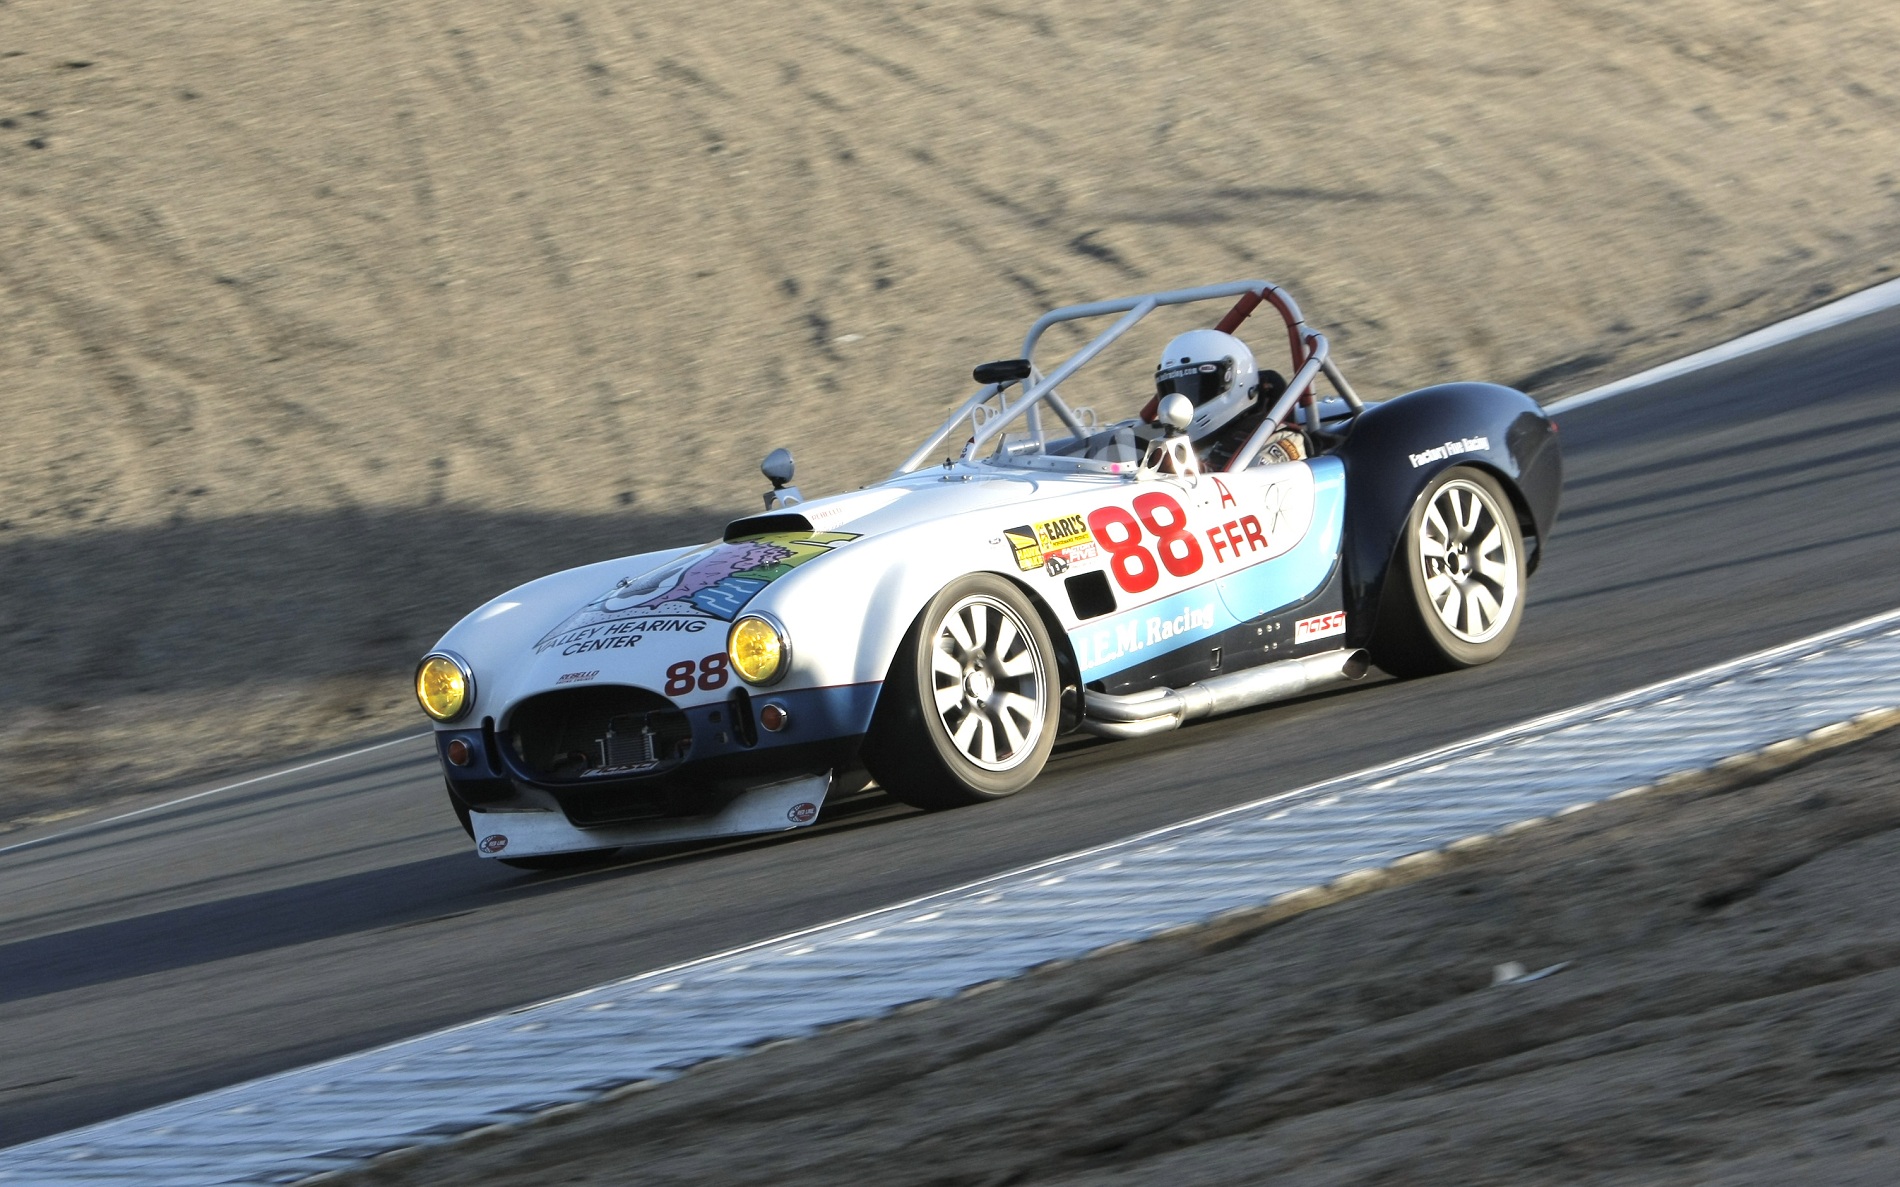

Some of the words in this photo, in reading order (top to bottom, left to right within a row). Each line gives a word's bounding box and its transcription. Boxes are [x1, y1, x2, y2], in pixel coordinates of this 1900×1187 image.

[1409, 445, 1448, 468] Factory
[1445, 441, 1465, 456] Five
[1462, 436, 1490, 452] Racing
[1212, 477, 1237, 509] A
[1044, 515, 1087, 540] EARL'S
[1088, 491, 1203, 593] 88
[1206, 514, 1269, 563] FFR
[1062, 542, 1095, 555] FACTORY
[1070, 547, 1096, 562] FIVE
[535, 625, 605, 656] VALLEY
[607, 619, 707, 637] HEARING
[1146, 604, 1215, 646] Racing
[562, 634, 642, 657] CENTER
[559, 670, 600, 680] REBELLO
[664, 651, 729, 697] 88
